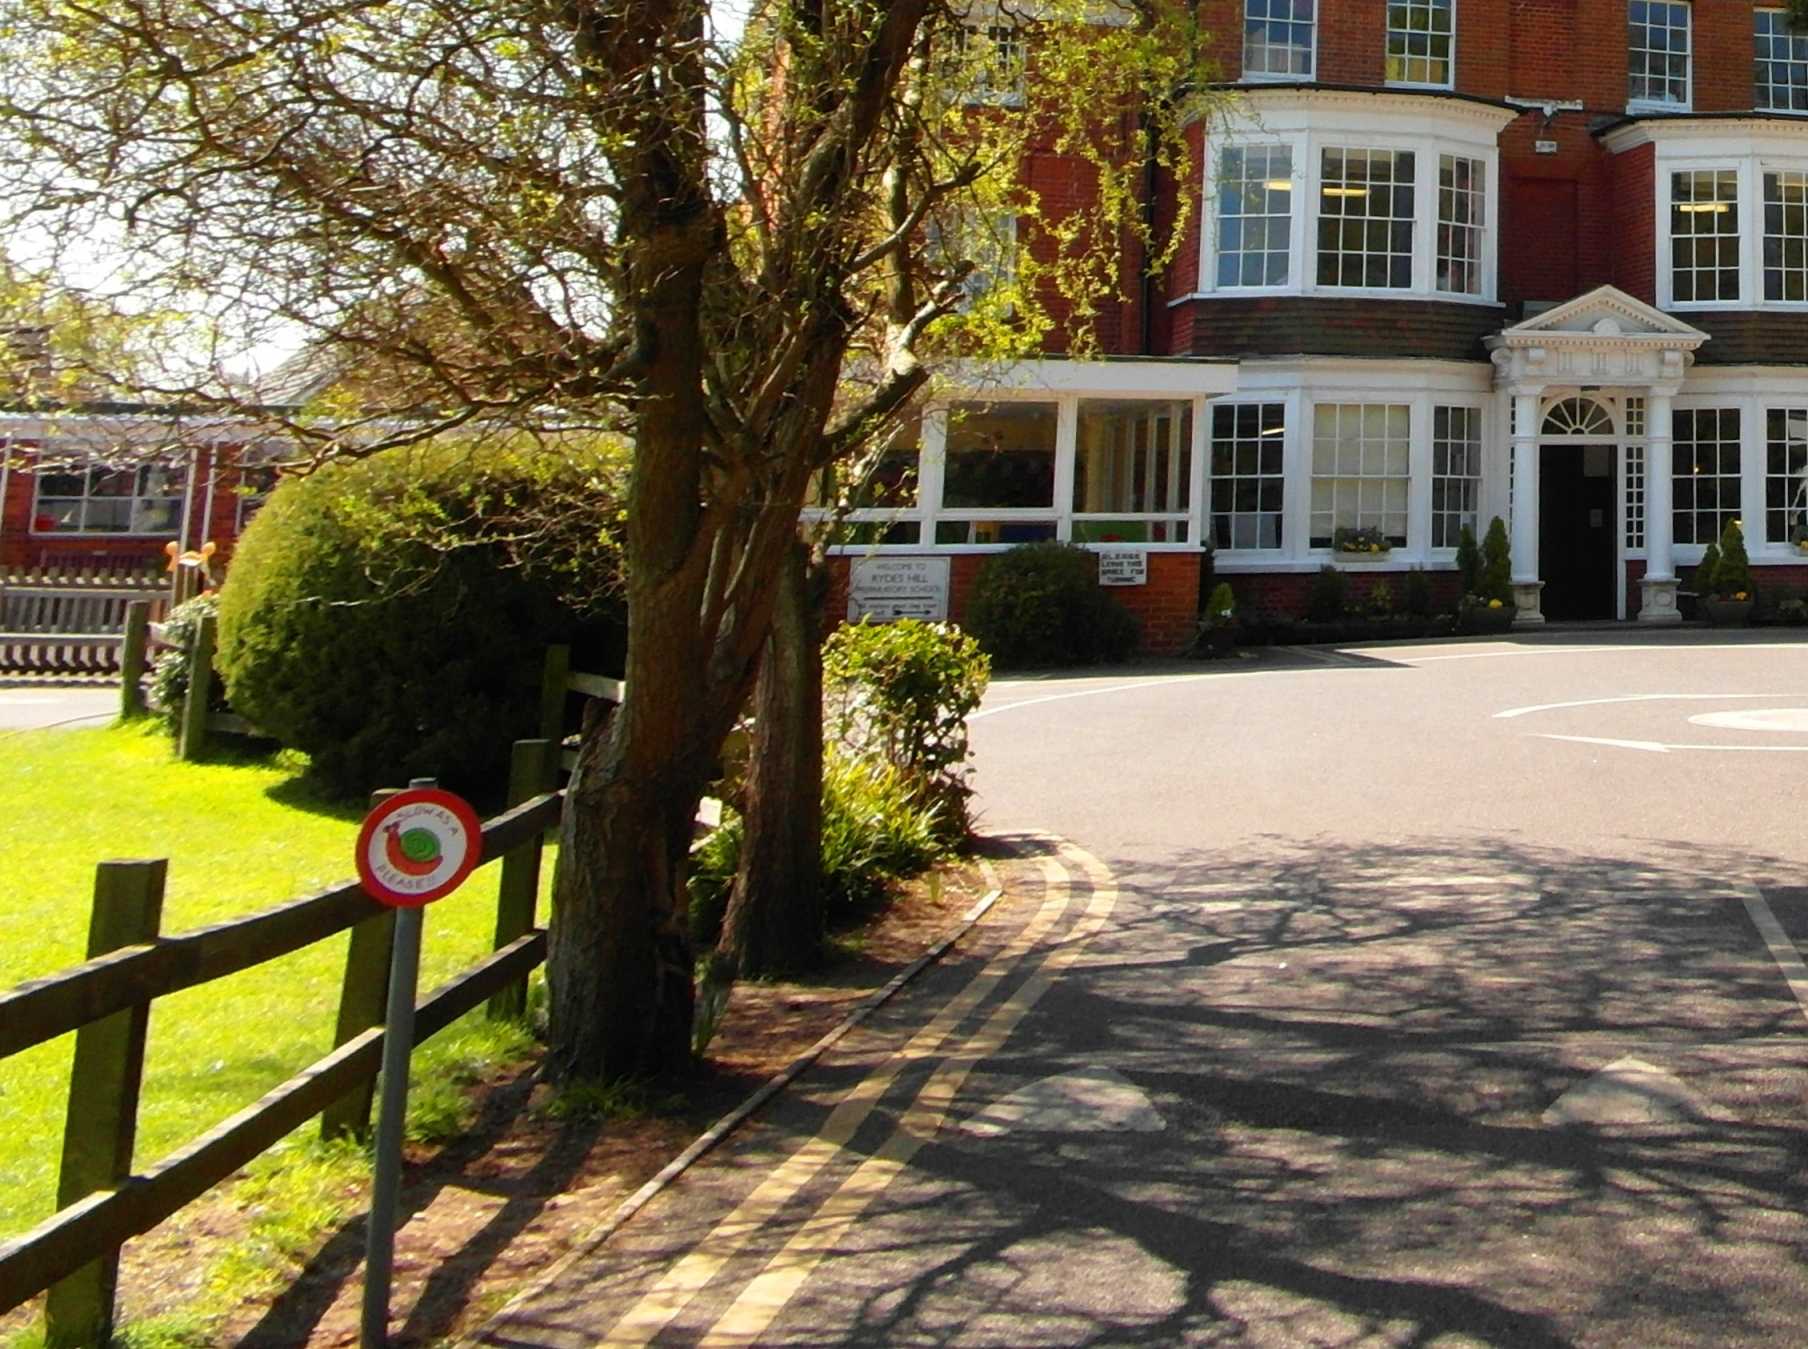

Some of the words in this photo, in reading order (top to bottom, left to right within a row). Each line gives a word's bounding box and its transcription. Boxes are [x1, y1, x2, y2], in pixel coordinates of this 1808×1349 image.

[876, 563, 913, 571] WELCOME
[916, 563, 926, 571] TO
[872, 573, 904, 583] RYDES
[907, 573, 928, 583] HILL
